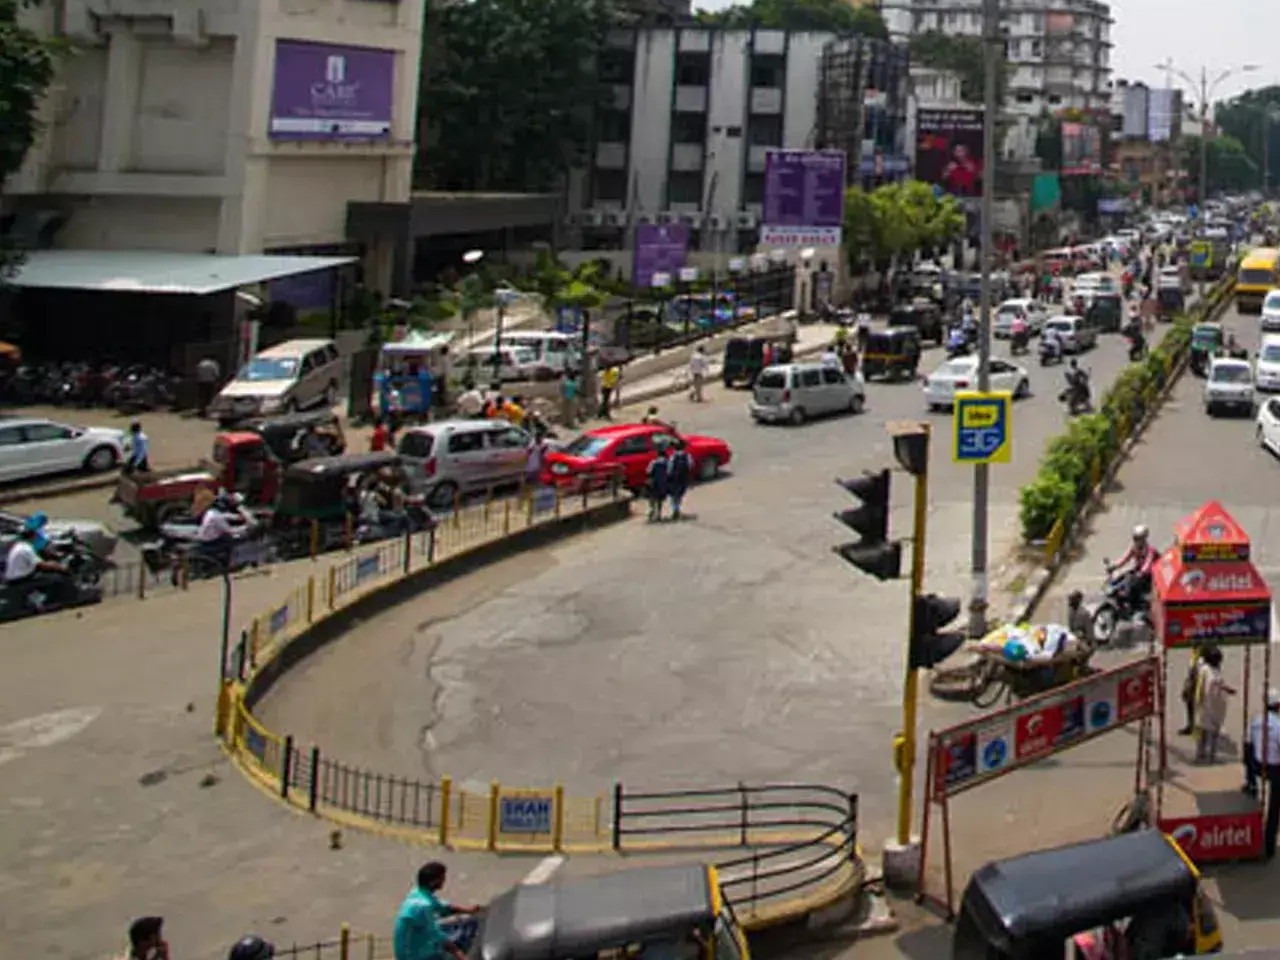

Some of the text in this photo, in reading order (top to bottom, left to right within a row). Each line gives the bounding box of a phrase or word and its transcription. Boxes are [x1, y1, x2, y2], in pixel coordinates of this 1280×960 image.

[961, 428, 1001, 452] 3G
[1206, 572, 1253, 591] airtel
[1199, 823, 1252, 850] airtel
